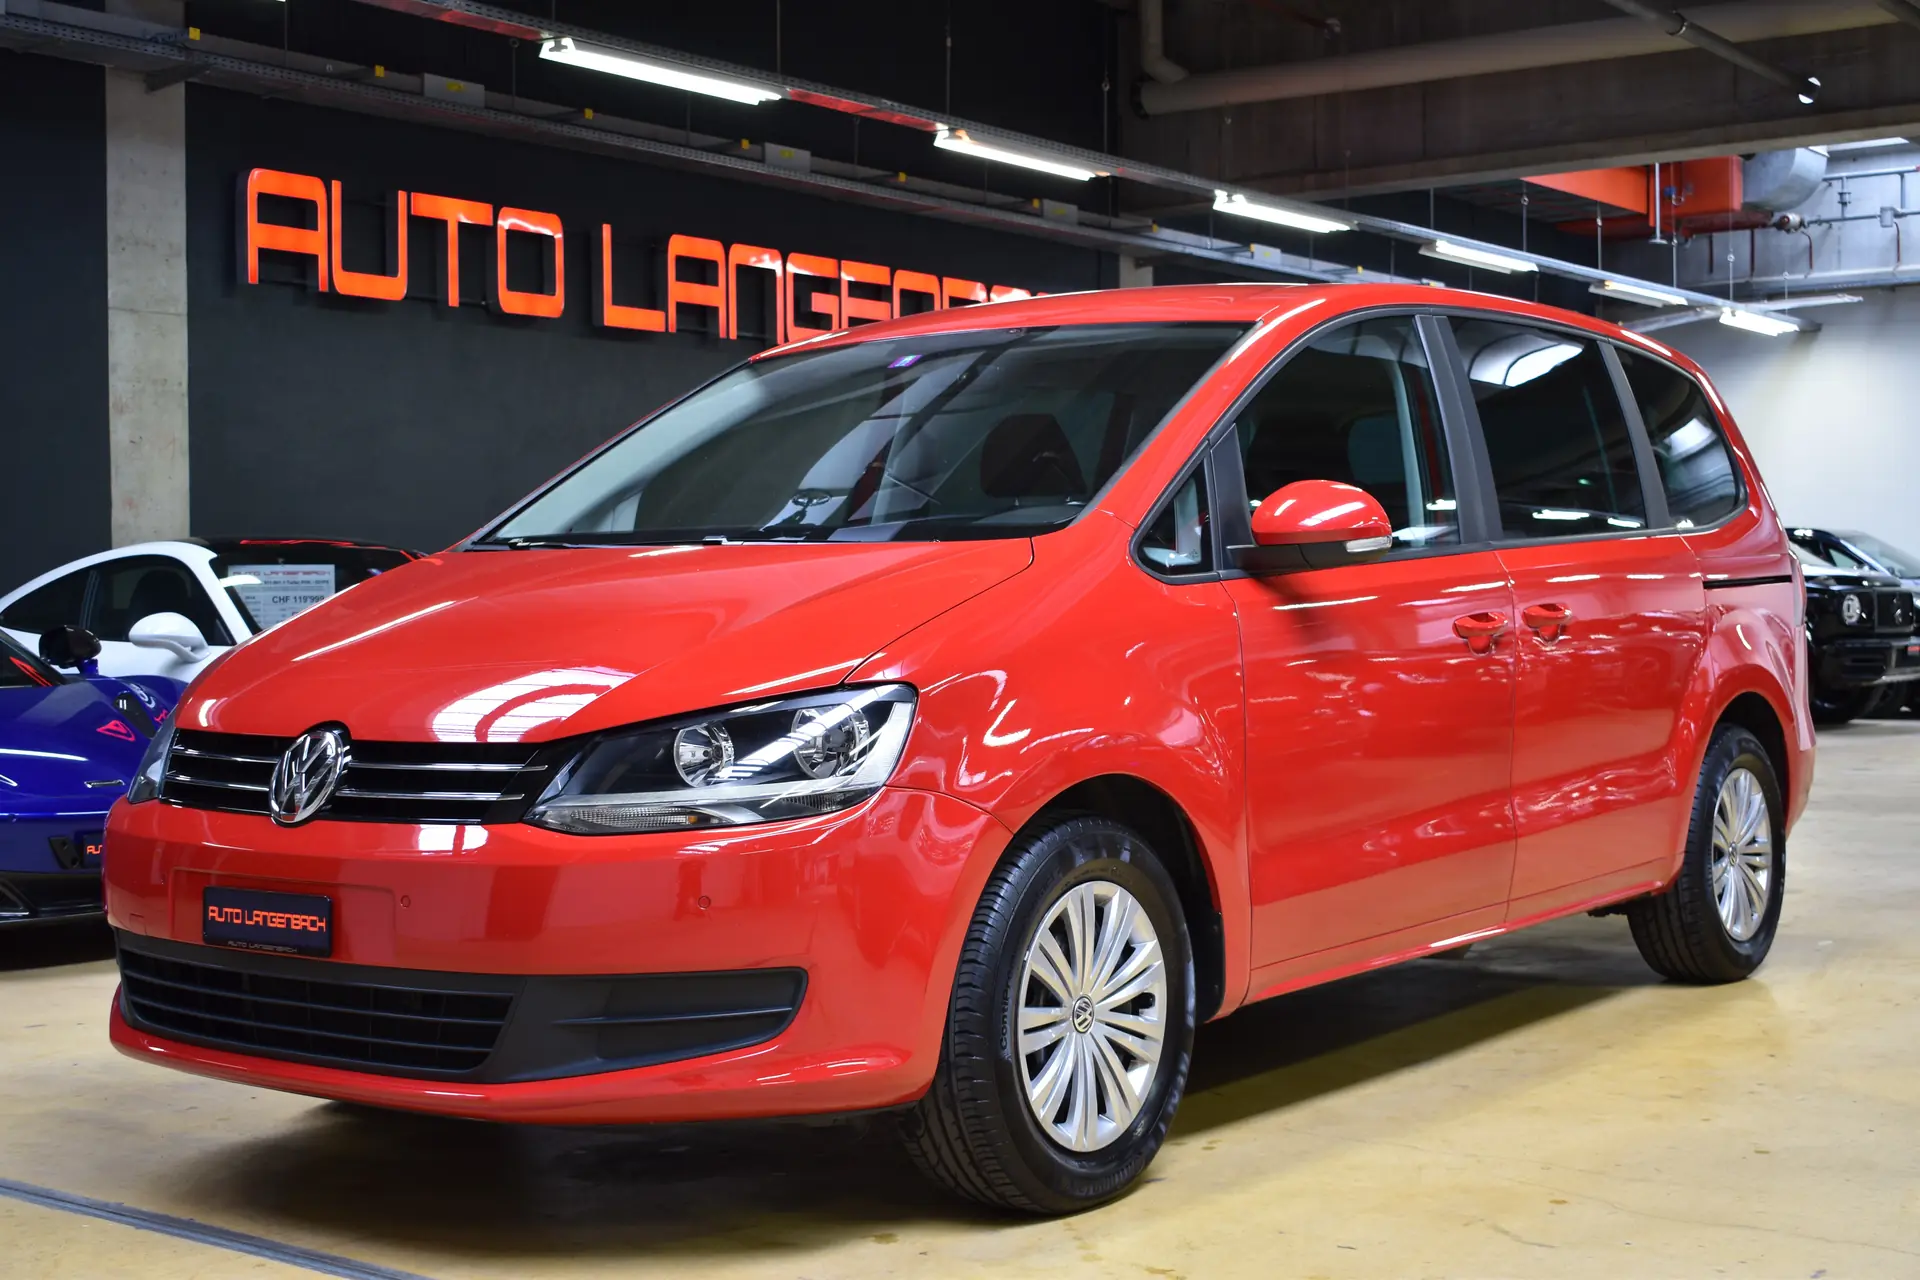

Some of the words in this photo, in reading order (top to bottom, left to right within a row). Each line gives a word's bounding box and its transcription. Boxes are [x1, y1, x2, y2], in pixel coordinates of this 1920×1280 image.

[247, 168, 565, 318] AUTO
[602, 223, 1048, 345] LANGEN
[271, 595, 291, 604] CHF
[86, 845, 103, 855] AU
[208, 905, 242, 924] AUTO
[244, 910, 326, 933] LANGENBACH
